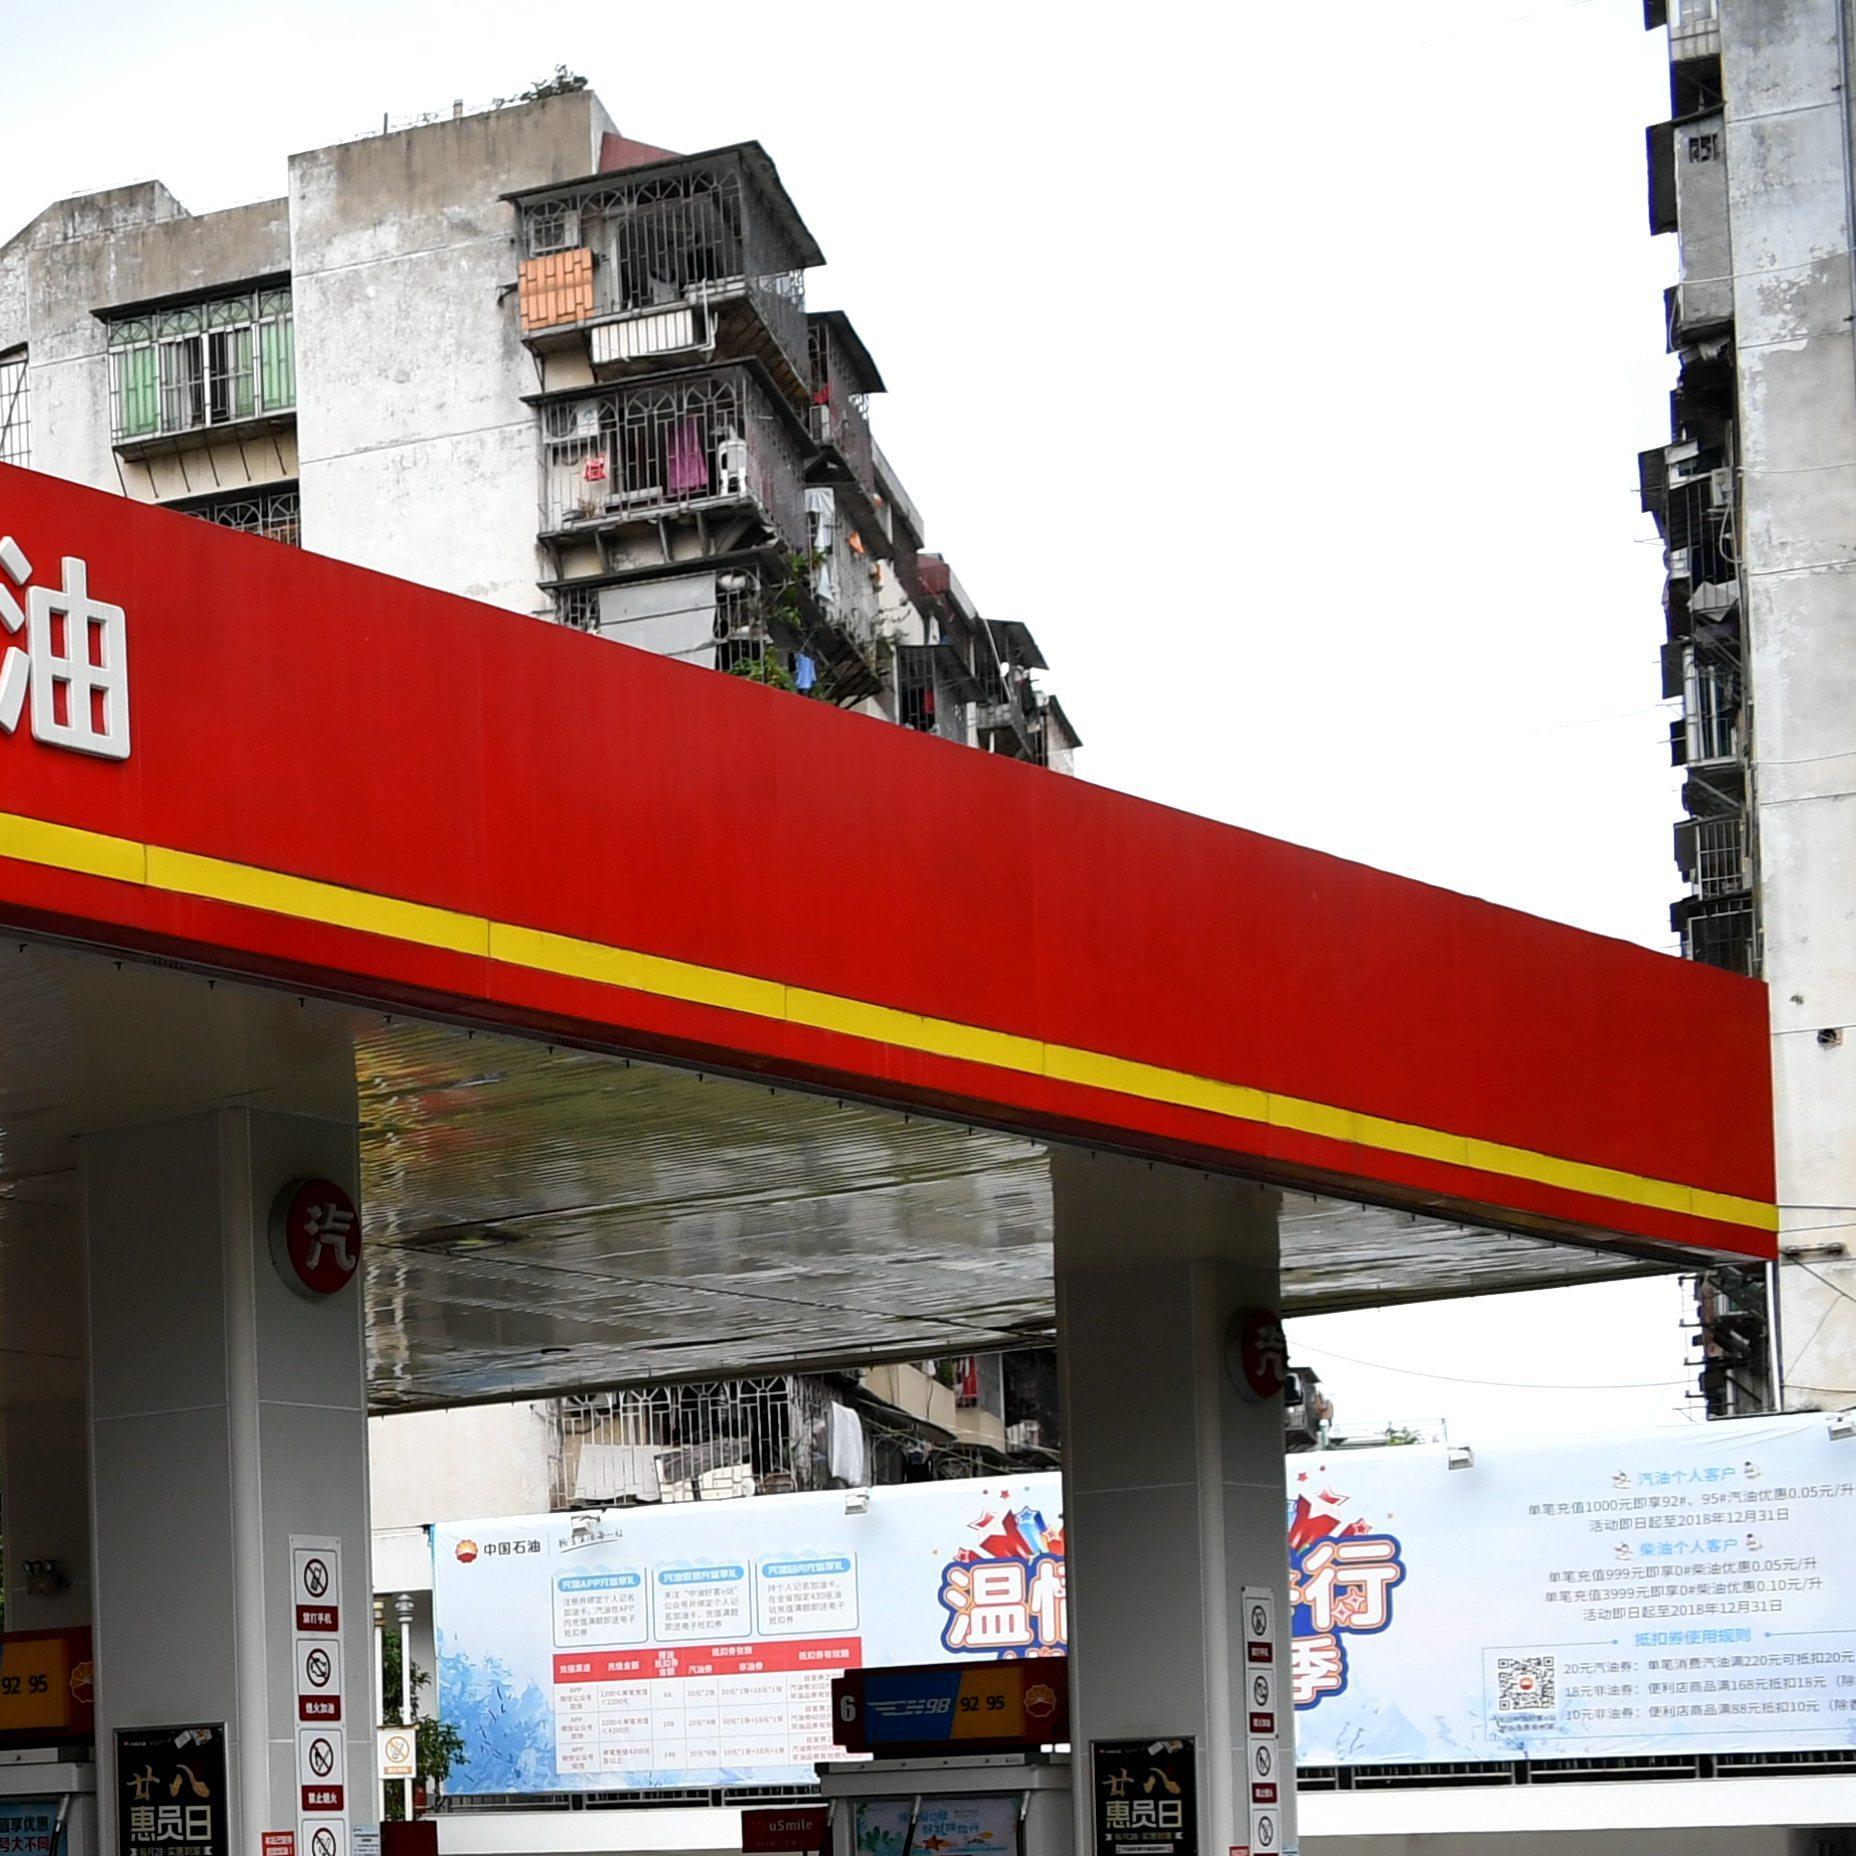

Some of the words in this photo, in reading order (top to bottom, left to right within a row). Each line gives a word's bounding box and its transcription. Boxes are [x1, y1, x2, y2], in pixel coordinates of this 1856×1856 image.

[304, 1203, 358, 1271] 汽
[1638, 1466, 1736, 1486] 汽油个人客户
[483, 1539, 541, 1556] 中国石油
[1639, 1538, 1738, 1557] 柴油个人客户
[1, 1676, 21, 1696] 92
[28, 1673, 48, 1694] 95
[840, 1695, 857, 1722] 6
[961, 1696, 980, 1713] 92
[987, 1695, 1005, 1712] 95
[130, 1805, 212, 1842] 惠员日
[769, 1819, 813, 1832] uSmile
[1106, 1800, 1183, 1829] 惠员日
